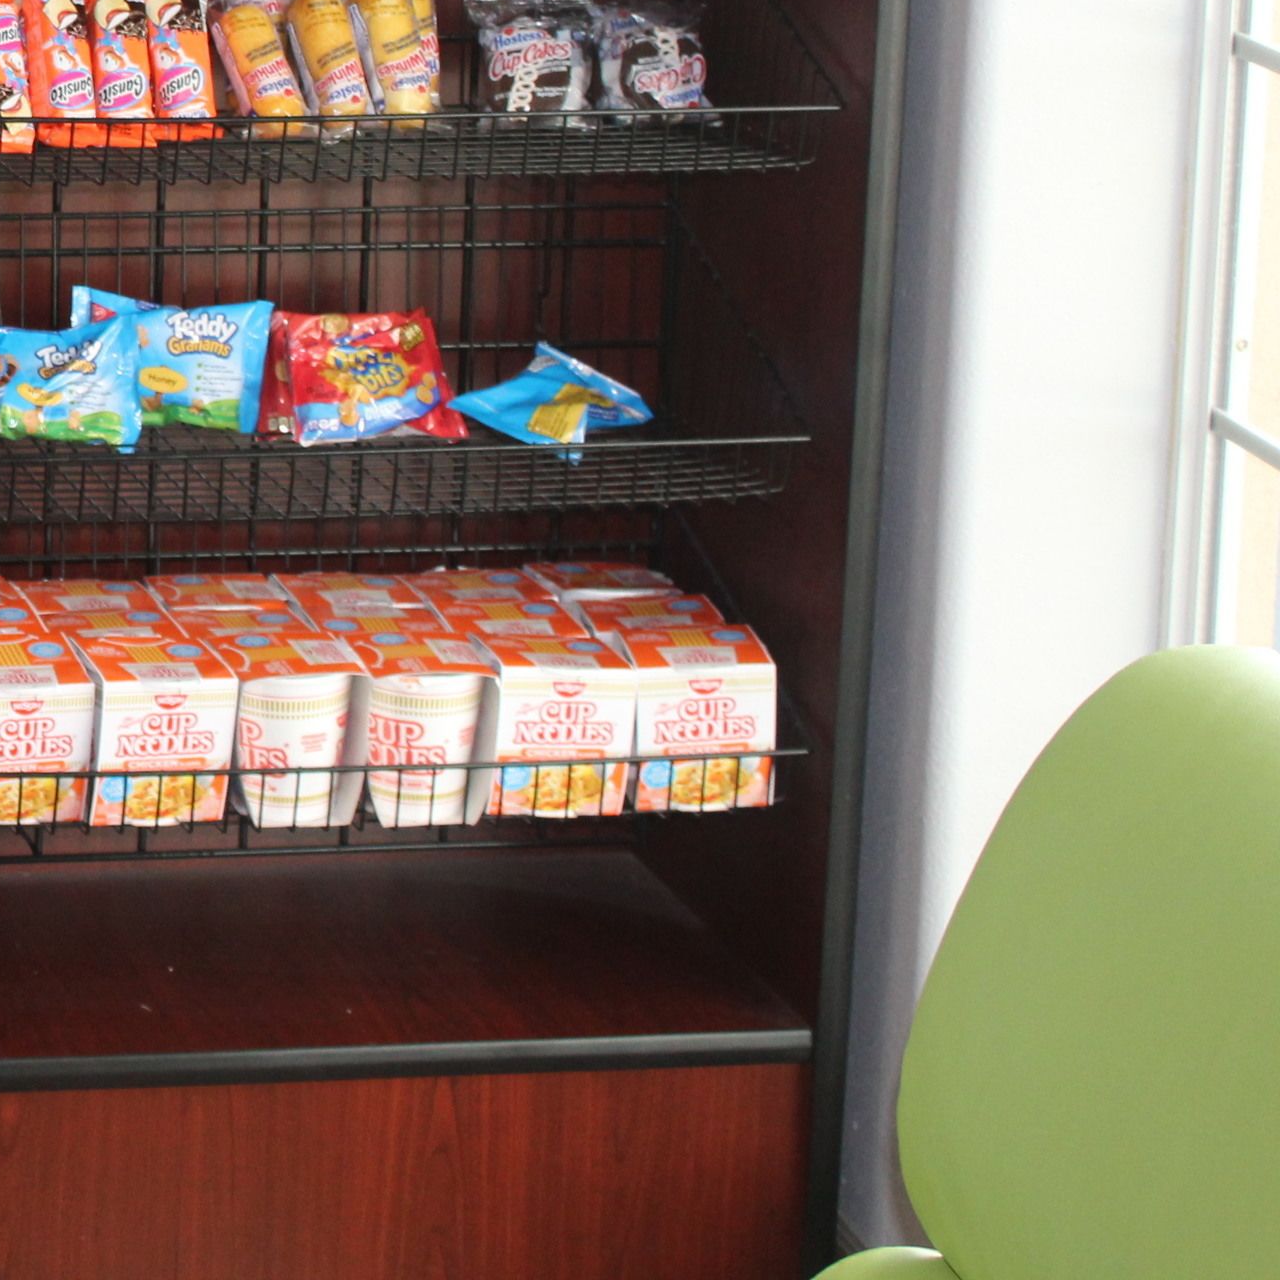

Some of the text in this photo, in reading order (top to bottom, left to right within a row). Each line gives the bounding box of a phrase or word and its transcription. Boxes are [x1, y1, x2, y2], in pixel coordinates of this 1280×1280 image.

[494, 29, 541, 50] Hostess
[160, 67, 202, 105] Gansit
[167, 311, 237, 344] Teddy
[167, 336, 231, 358] Grahams
[147, 372, 177, 387] Honey
[539, 700, 598, 725] CUP
[677, 697, 737, 722] CUP
[142, 711, 199, 736] CUP
[512, 720, 616, 747] NOODLES
[653, 715, 758, 746] NOODLES
[114, 730, 216, 759] NOODLES
